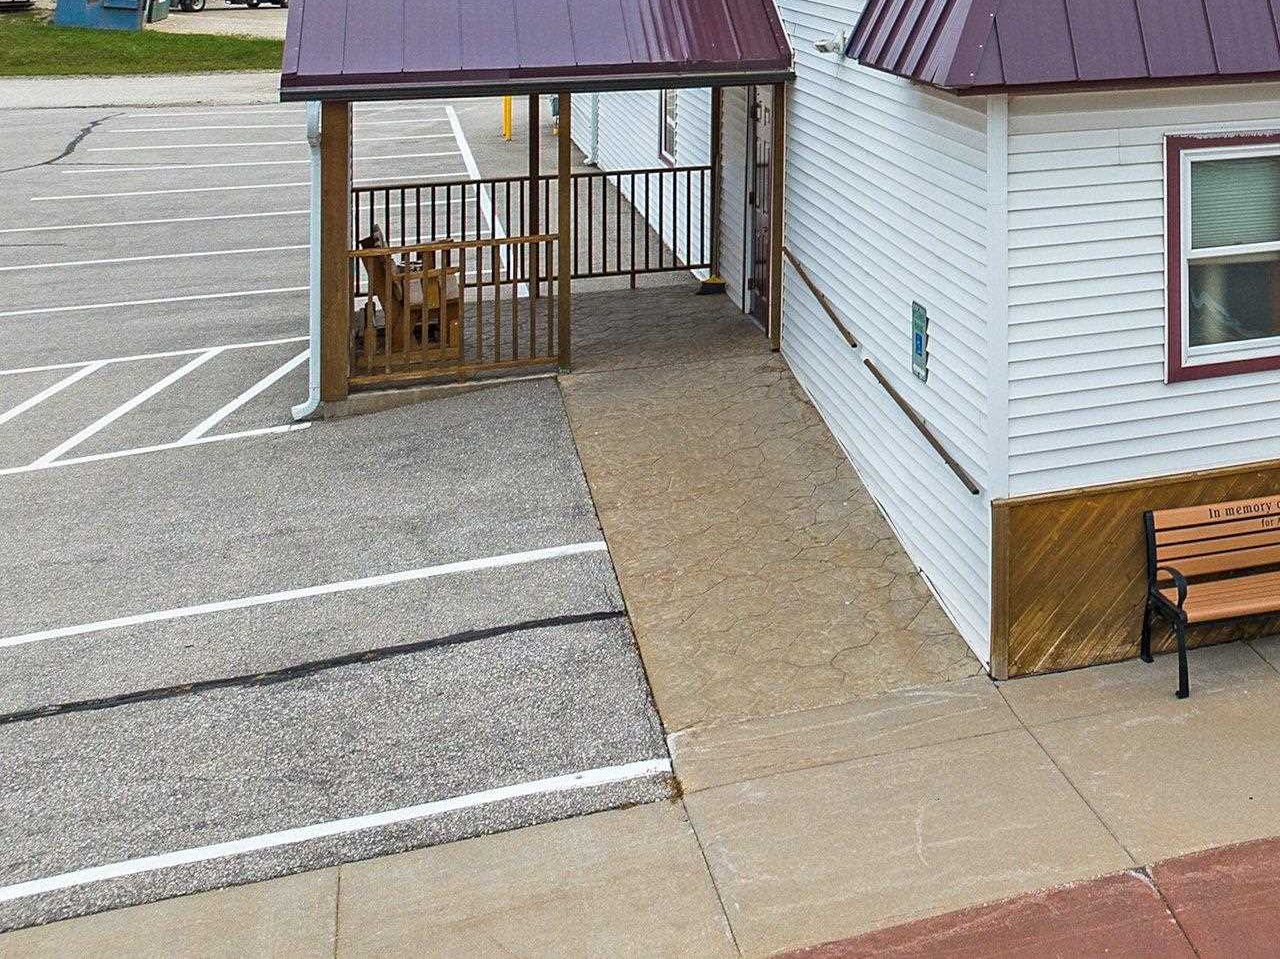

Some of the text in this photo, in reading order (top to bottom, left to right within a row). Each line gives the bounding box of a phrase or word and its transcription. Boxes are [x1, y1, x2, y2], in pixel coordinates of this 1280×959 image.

[1208, 508, 1220, 519] In
[1225, 502, 1272, 517] memory
[1261, 517, 1273, 528] for
